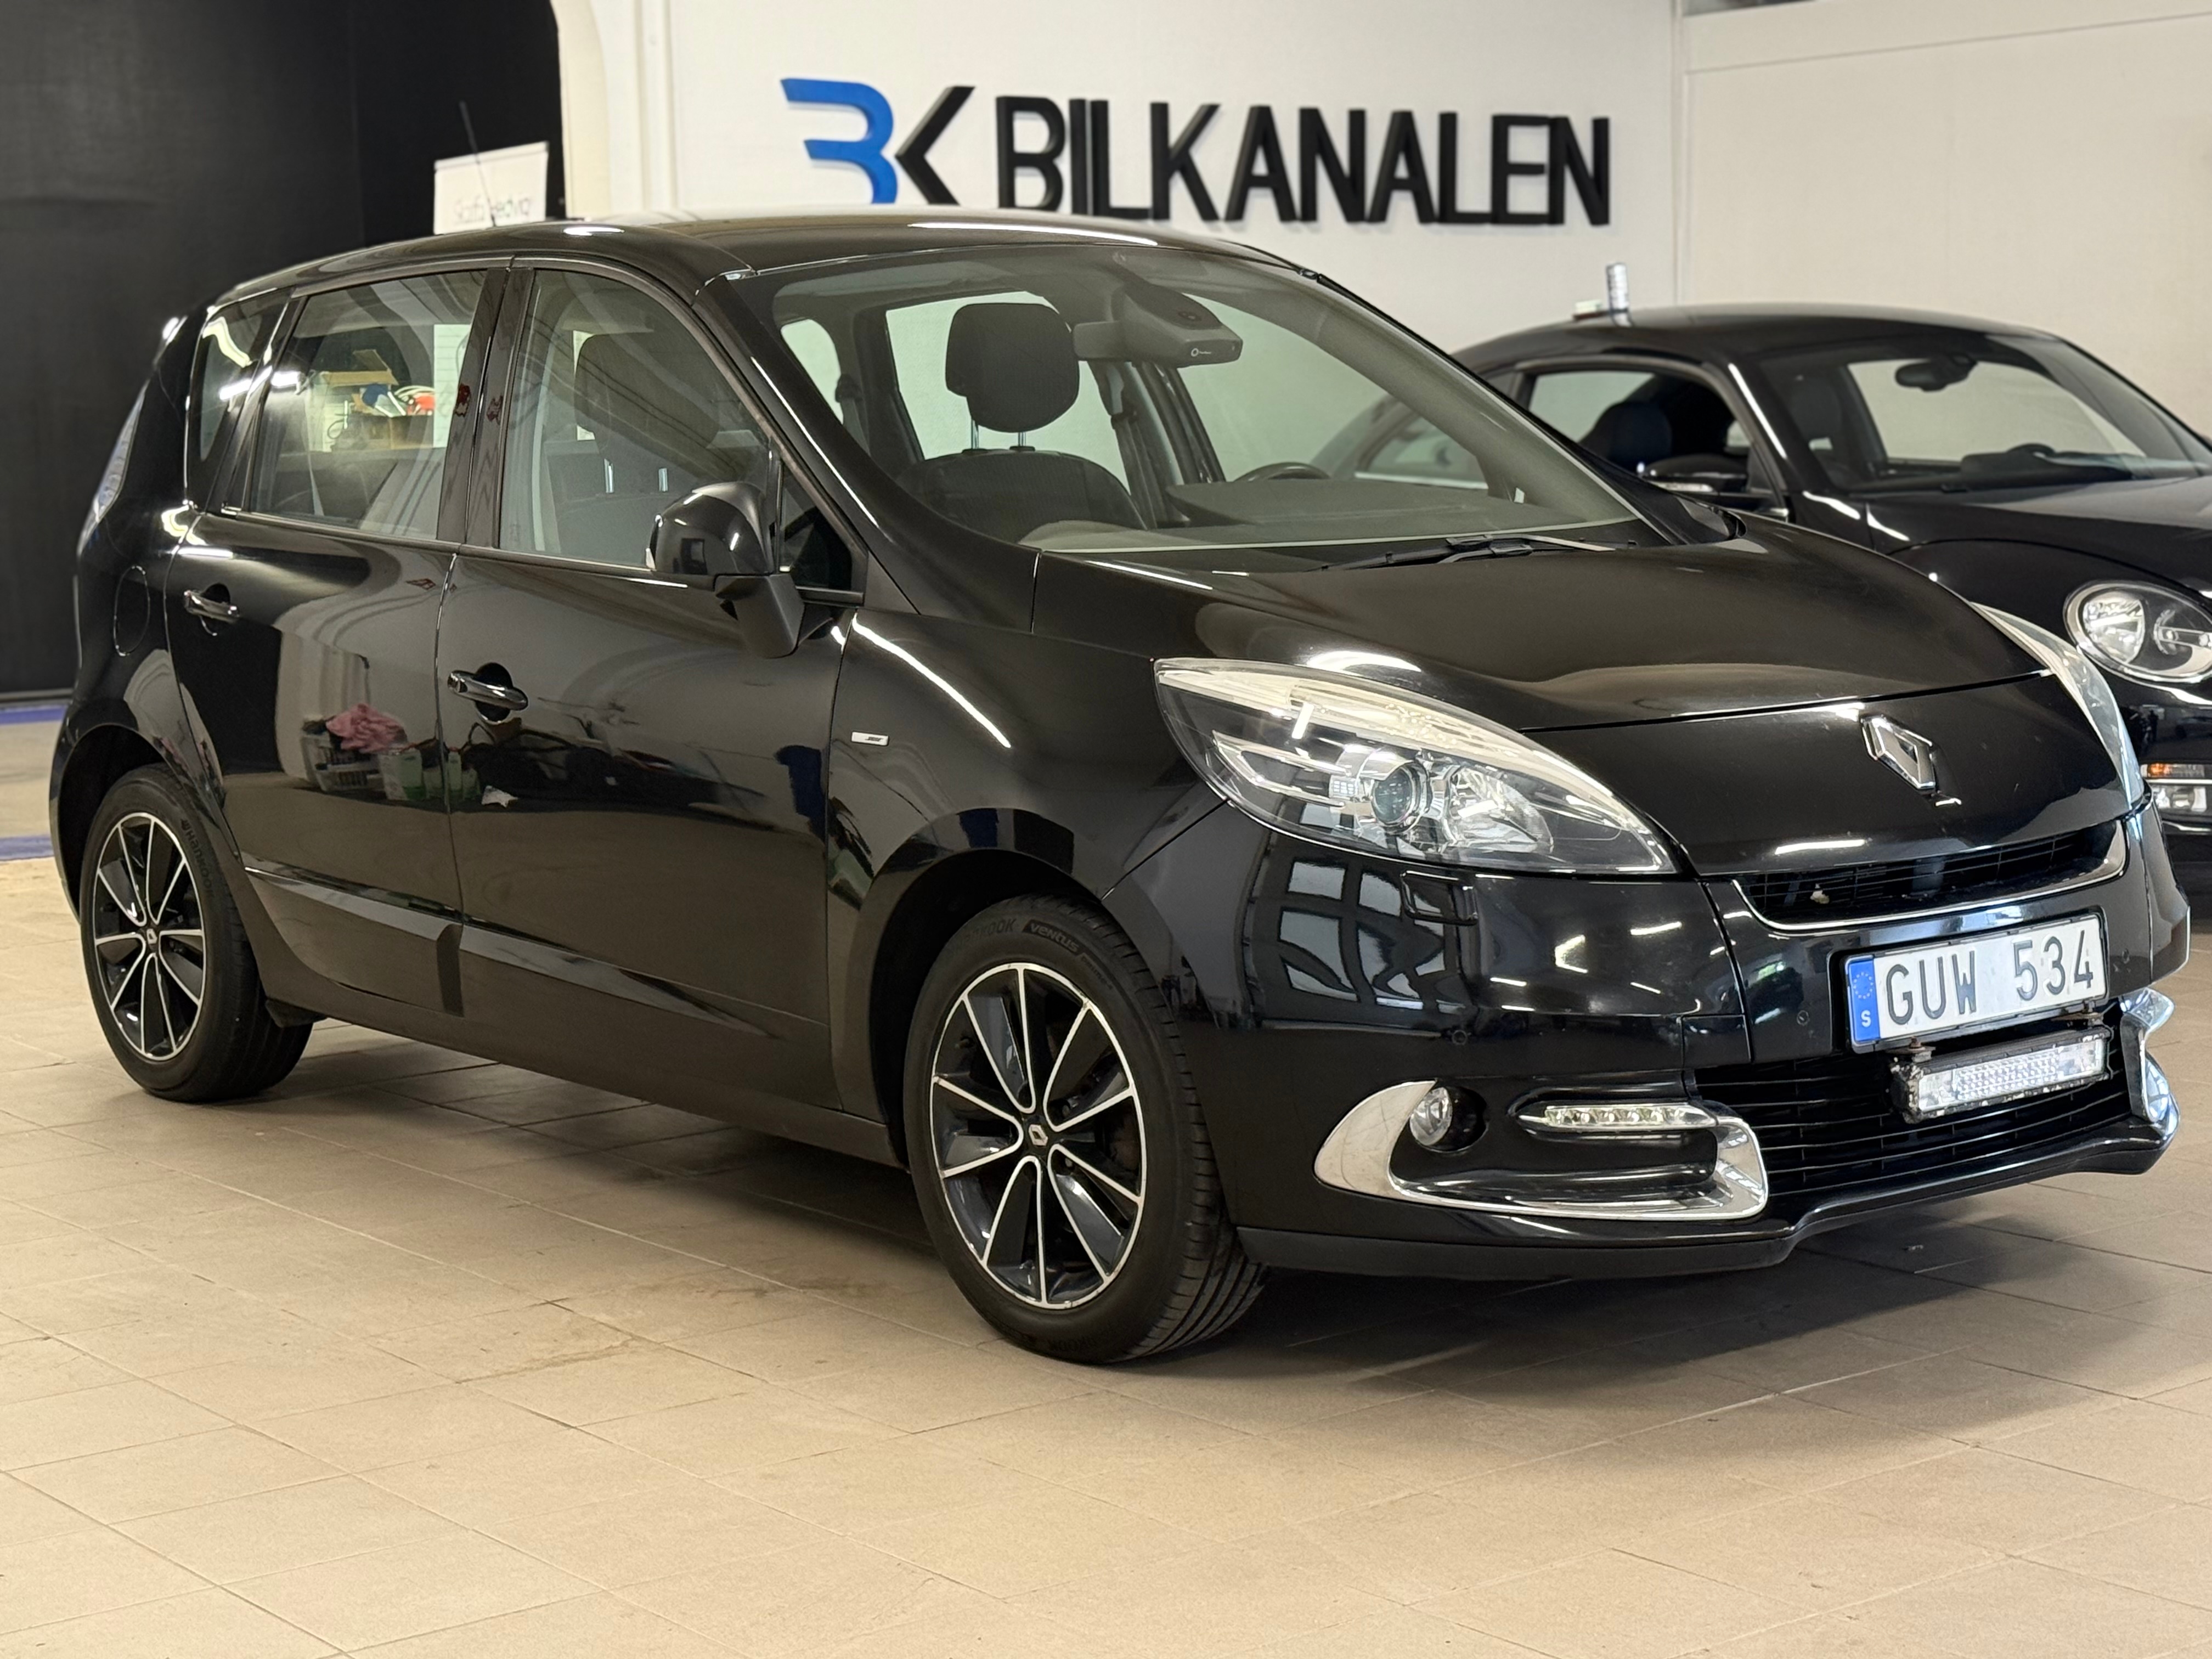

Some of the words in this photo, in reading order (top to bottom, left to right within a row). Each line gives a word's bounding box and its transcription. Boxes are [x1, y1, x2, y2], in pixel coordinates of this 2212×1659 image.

[996, 95, 1610, 226] BILKANALEN
[1861, 1009, 1871, 1028] S
[1886, 950, 1977, 1025] GUW
[2013, 930, 2094, 1001] 534
